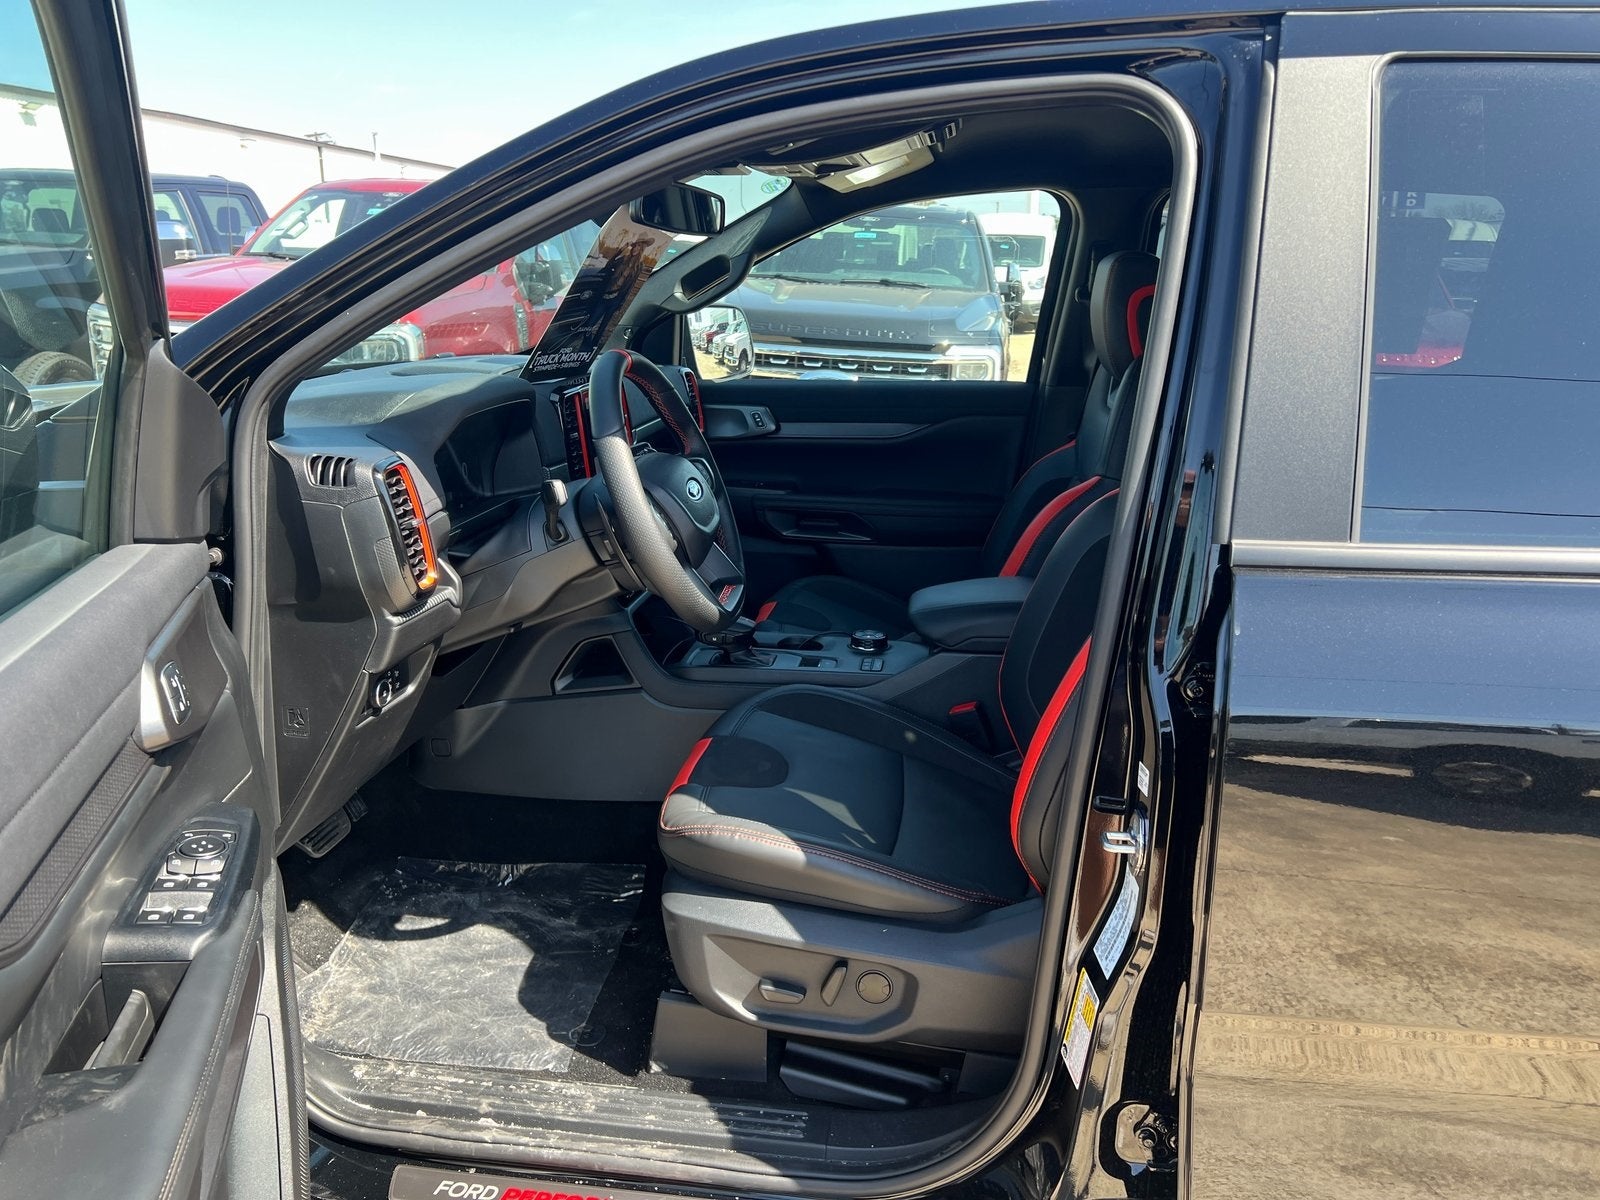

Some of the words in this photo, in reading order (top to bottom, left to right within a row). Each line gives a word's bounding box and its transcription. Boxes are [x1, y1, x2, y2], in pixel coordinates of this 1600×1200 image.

[750, 321, 840, 336] SUPER
[846, 327, 918, 341] DUTY
[433, 1180, 500, 1200] FORD
